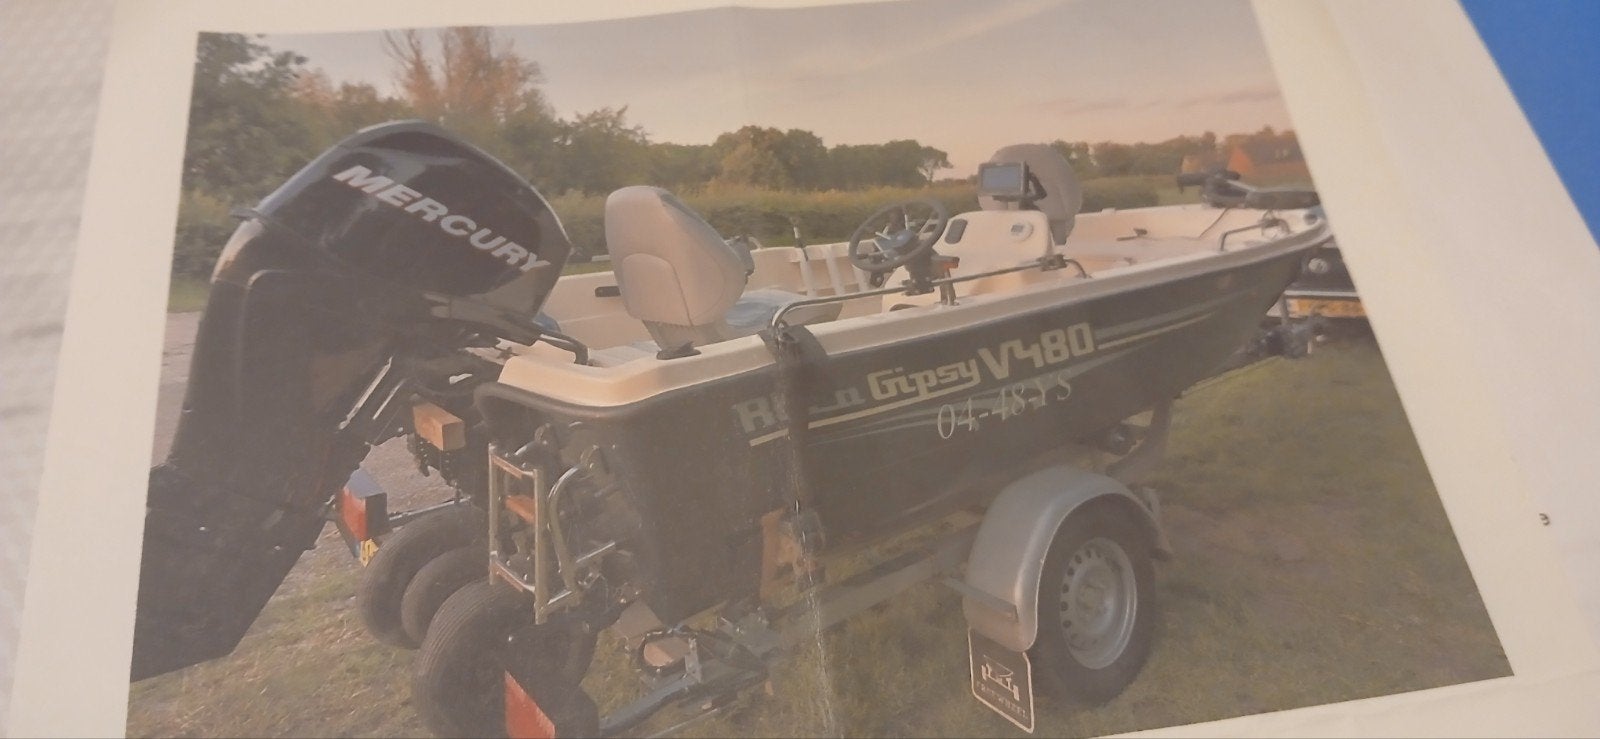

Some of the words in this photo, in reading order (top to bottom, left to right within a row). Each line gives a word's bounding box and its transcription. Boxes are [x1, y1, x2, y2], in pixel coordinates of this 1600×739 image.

[333, 164, 550, 273] MERCURY
[866, 358, 982, 401] Gipsy
[978, 321, 1095, 380] V480
